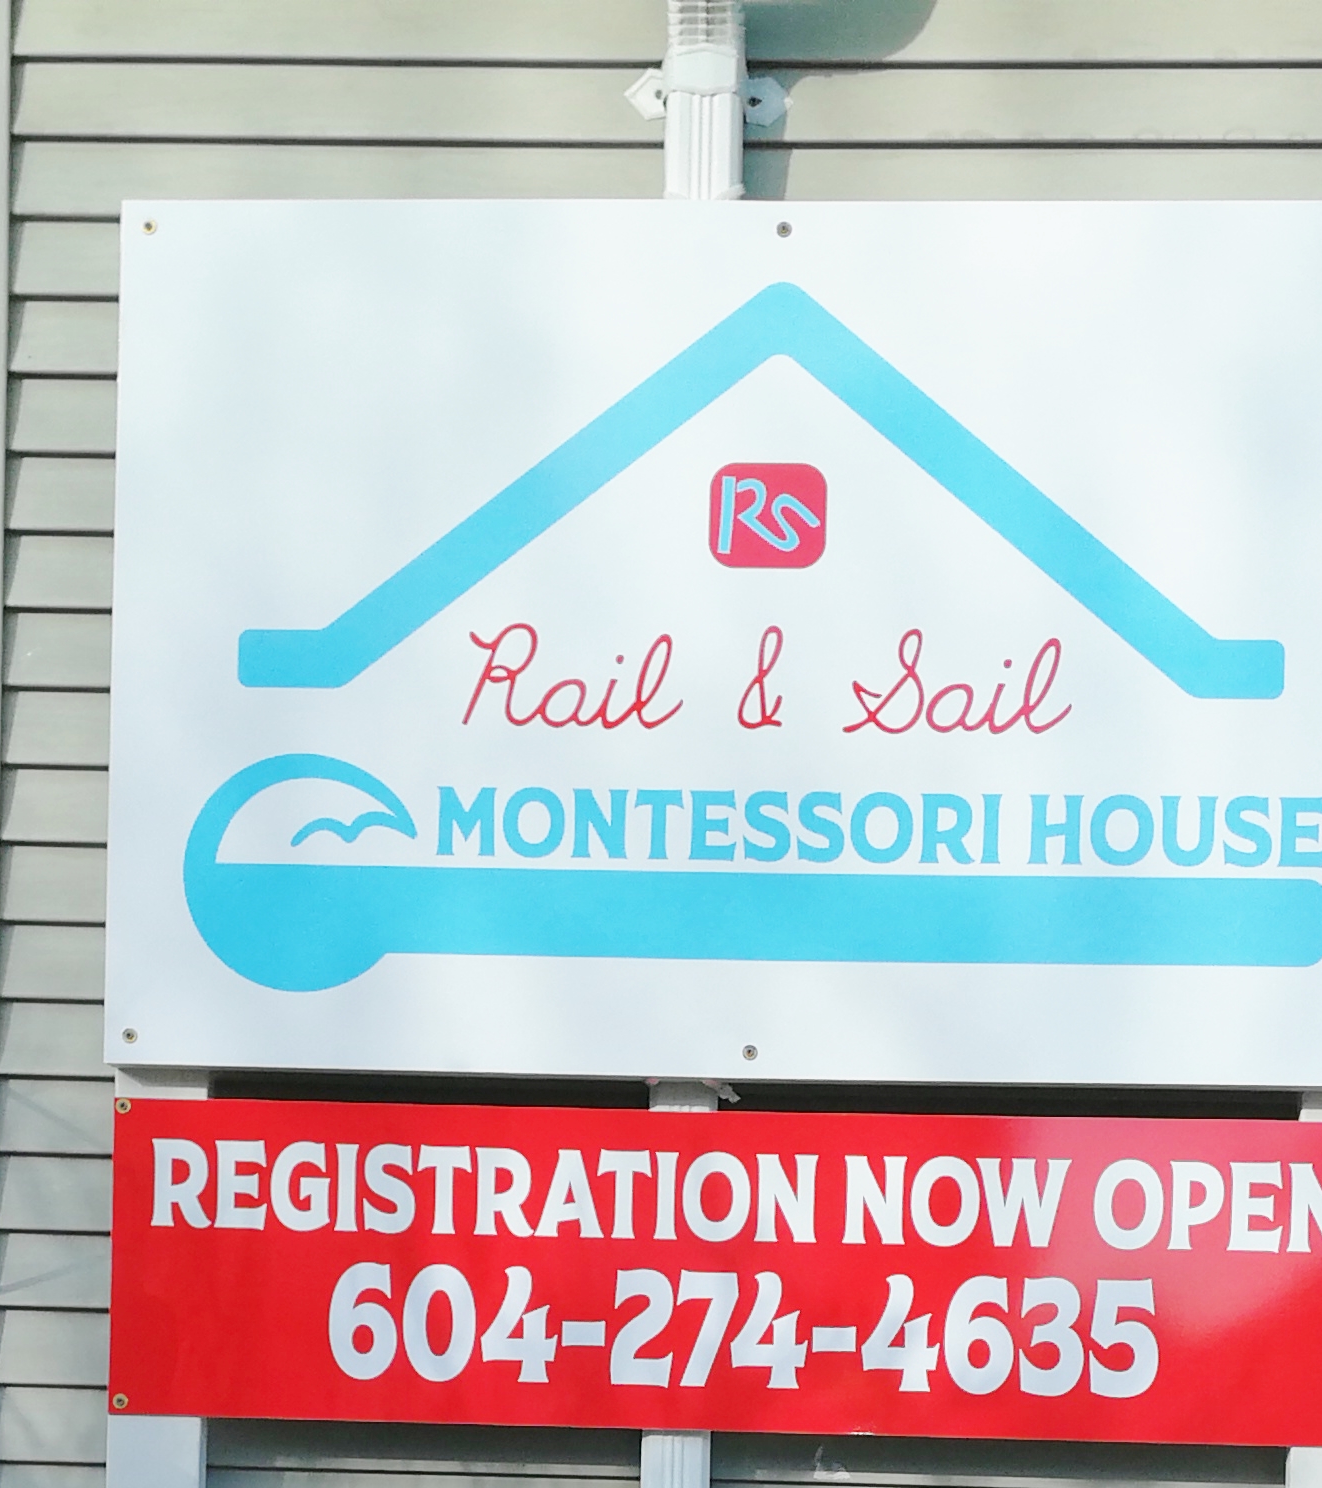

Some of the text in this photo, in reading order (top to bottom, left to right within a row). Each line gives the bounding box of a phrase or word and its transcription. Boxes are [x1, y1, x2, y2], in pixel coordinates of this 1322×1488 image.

[462, 622, 1072, 735] Rail & Sail
[436, 785, 1002, 865] MONTESSORI
[150, 1137, 819, 1244] REGISTRATION
[841, 1154, 1073, 1249] NOW
[328, 1261, 1159, 1399] 604-274-4635
